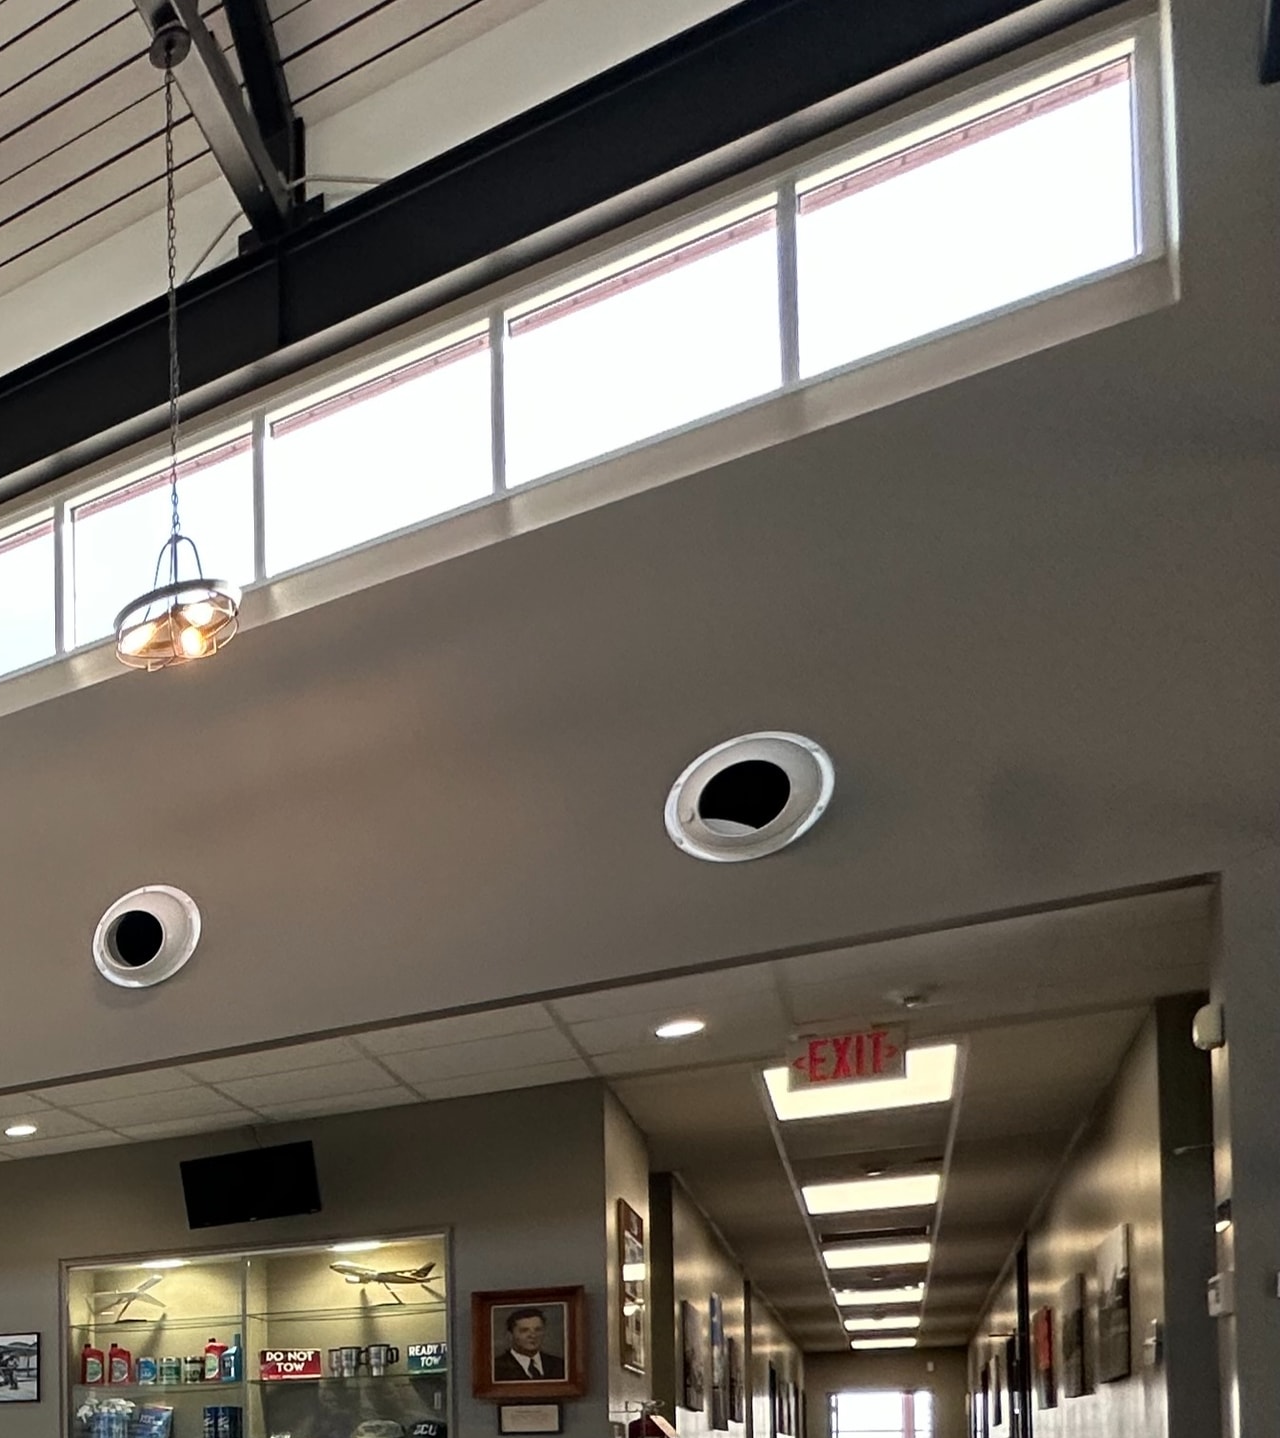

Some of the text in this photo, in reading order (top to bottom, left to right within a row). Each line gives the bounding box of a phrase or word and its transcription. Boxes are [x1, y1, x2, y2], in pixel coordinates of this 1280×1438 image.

[808, 1031, 888, 1082] EXIT
[265, 1350, 315, 1362] DO NOT
[408, 1344, 439, 1357] READY
[276, 1361, 305, 1373] TOW
[420, 1355, 442, 1367] TOW
